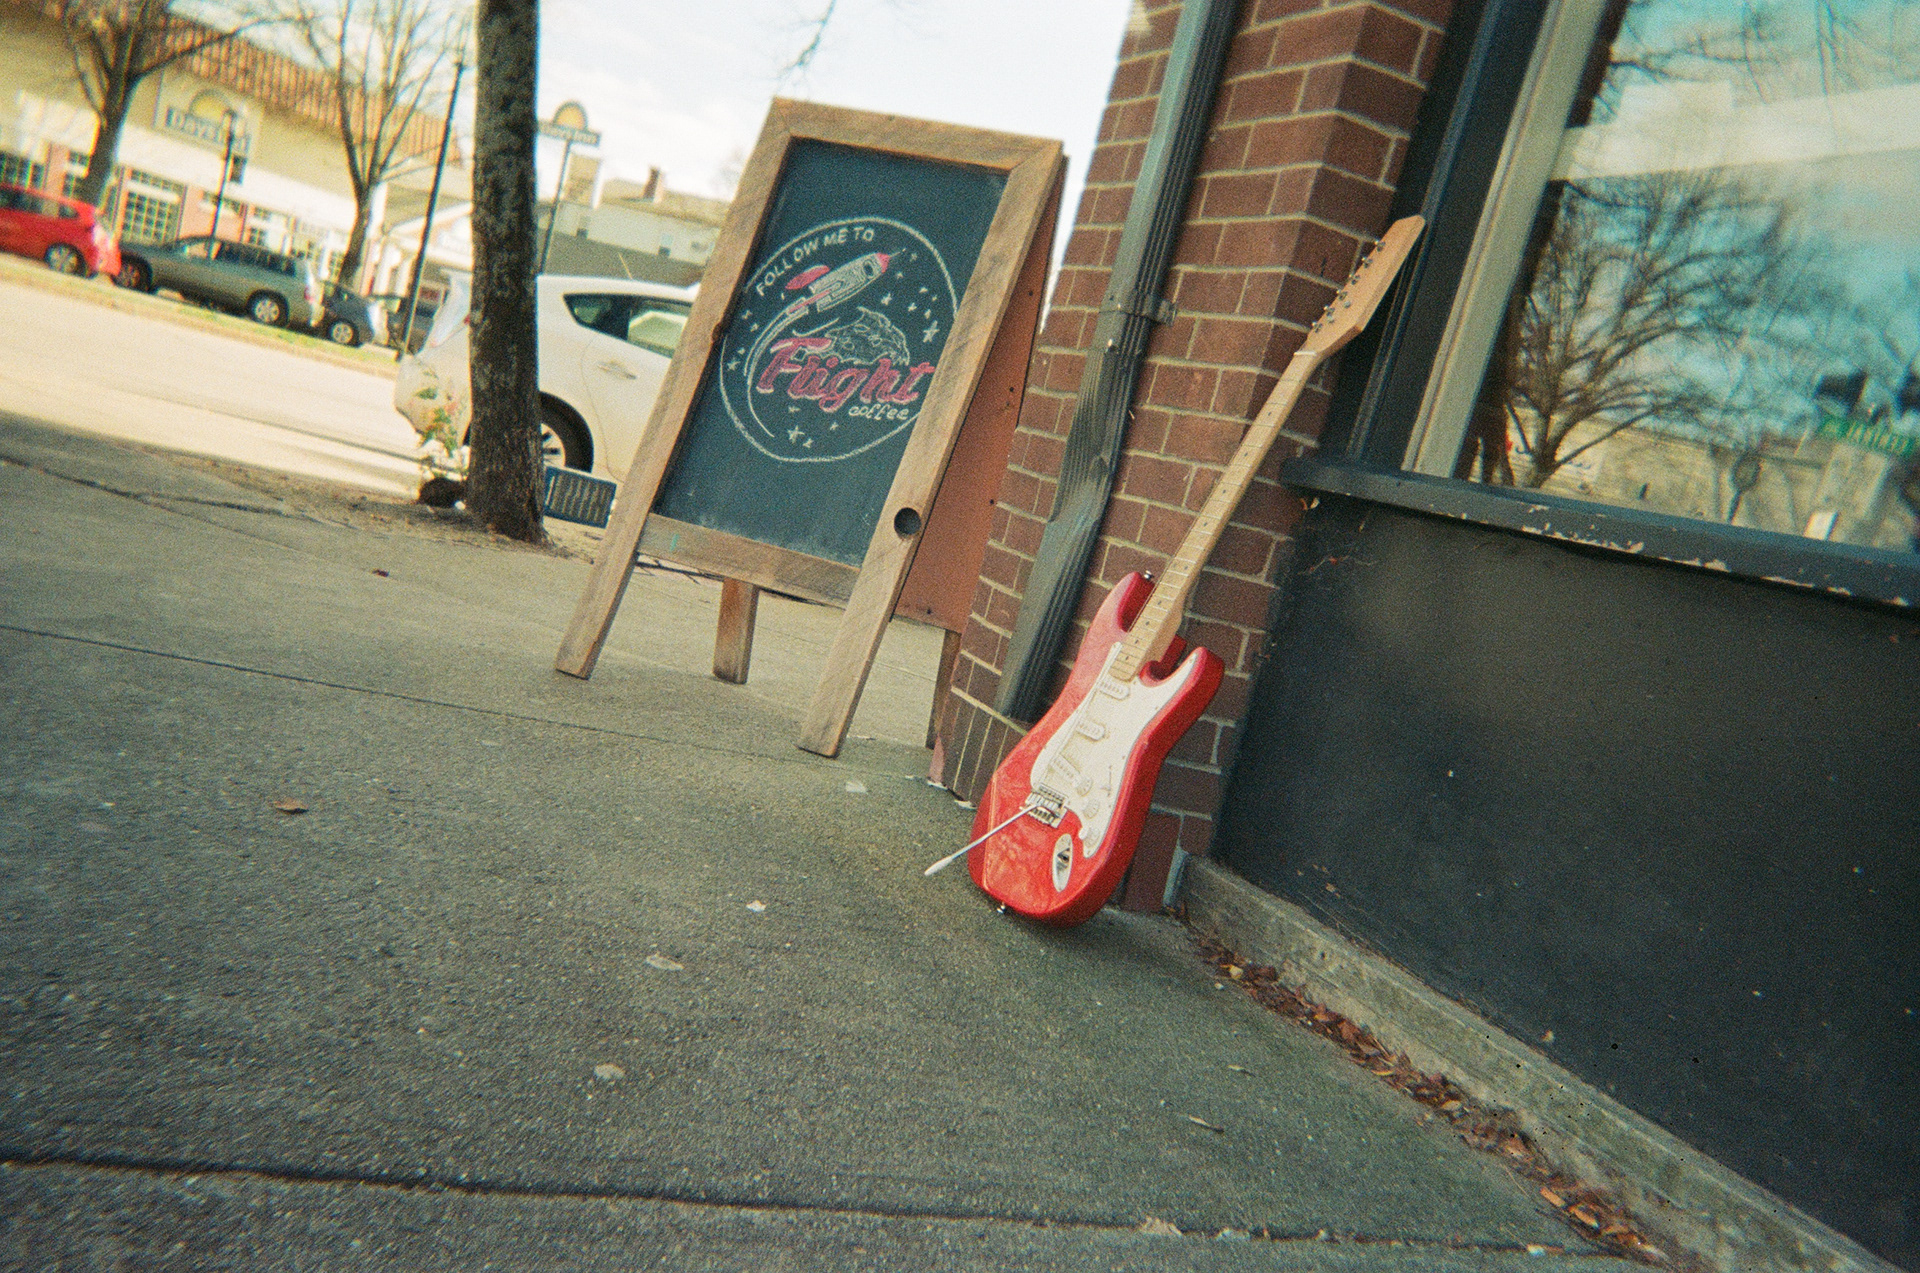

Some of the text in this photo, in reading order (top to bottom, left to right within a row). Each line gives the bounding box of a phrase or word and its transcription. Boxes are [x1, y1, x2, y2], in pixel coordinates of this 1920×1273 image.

[756, 226, 875, 297] FOLLOW ME TO
[756, 337, 935, 413] Flight
[849, 403, 909, 421] coffee
